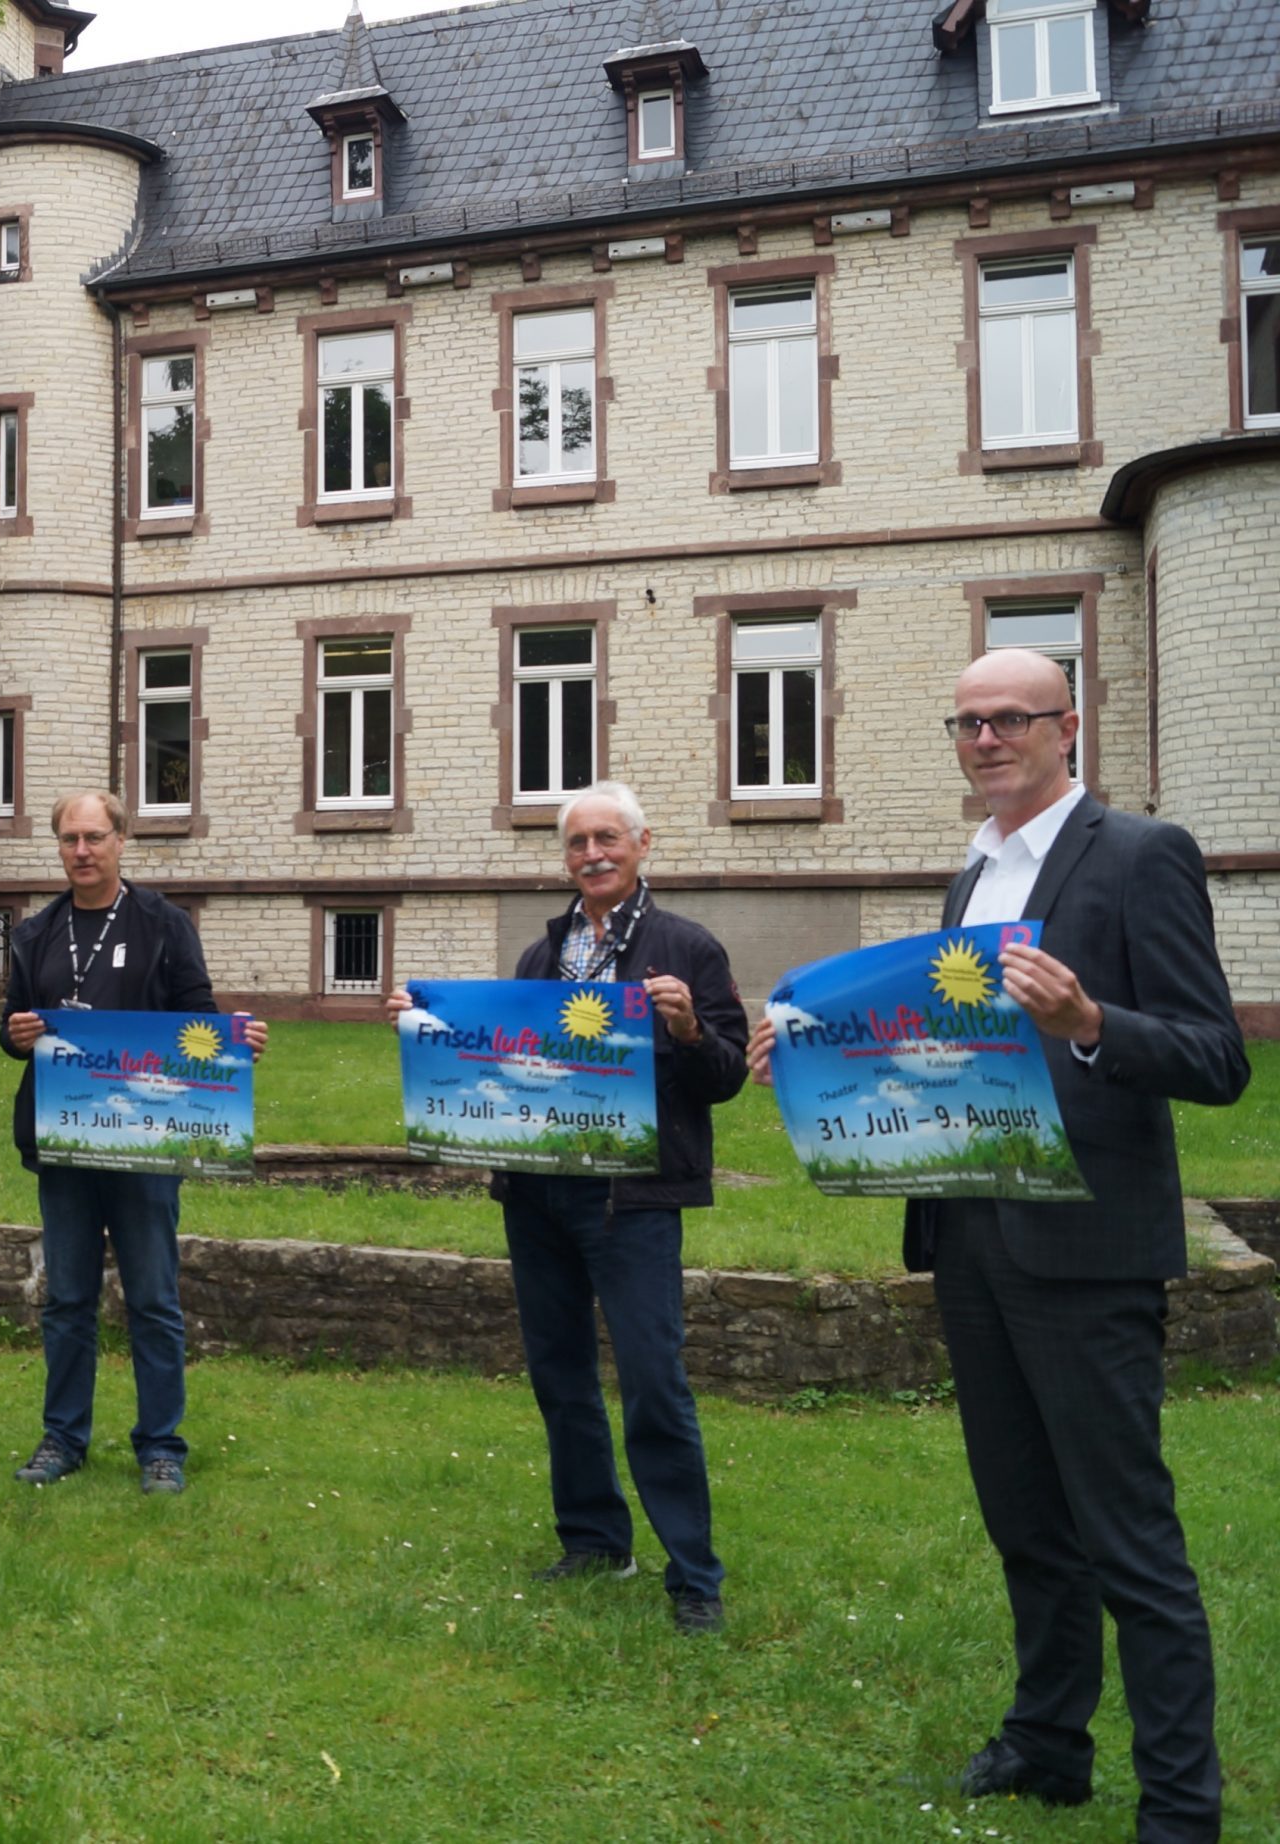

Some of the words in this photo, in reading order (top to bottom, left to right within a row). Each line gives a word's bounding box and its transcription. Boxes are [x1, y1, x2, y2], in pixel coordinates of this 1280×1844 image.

[786, 1003, 1019, 1048] Frischluftkultur
[417, 1022, 633, 1064] Frischluftkultur
[52, 1046, 239, 1083] Frischluftkultur
[926, 1058, 974, 1070] Kabarett
[818, 1083, 859, 1103] Theater
[887, 1078, 959, 1092] Kindertheater
[982, 1074, 1017, 1094] Lesung
[59, 1110, 85, 1126] 31.
[91, 1111, 121, 1128] Juli
[143, 1115, 159, 1131] 9.
[166, 1117, 230, 1138] August
[426, 1097, 452, 1116] 31.
[459, 1100, 494, 1119] Juli
[520, 1104, 537, 1123] 9.
[546, 1107, 626, 1131] August
[817, 1116, 856, 1141] 31.
[865, 1107, 909, 1137] Juli
[935, 1105, 959, 1129] 9.
[967, 1103, 1040, 1134] August
